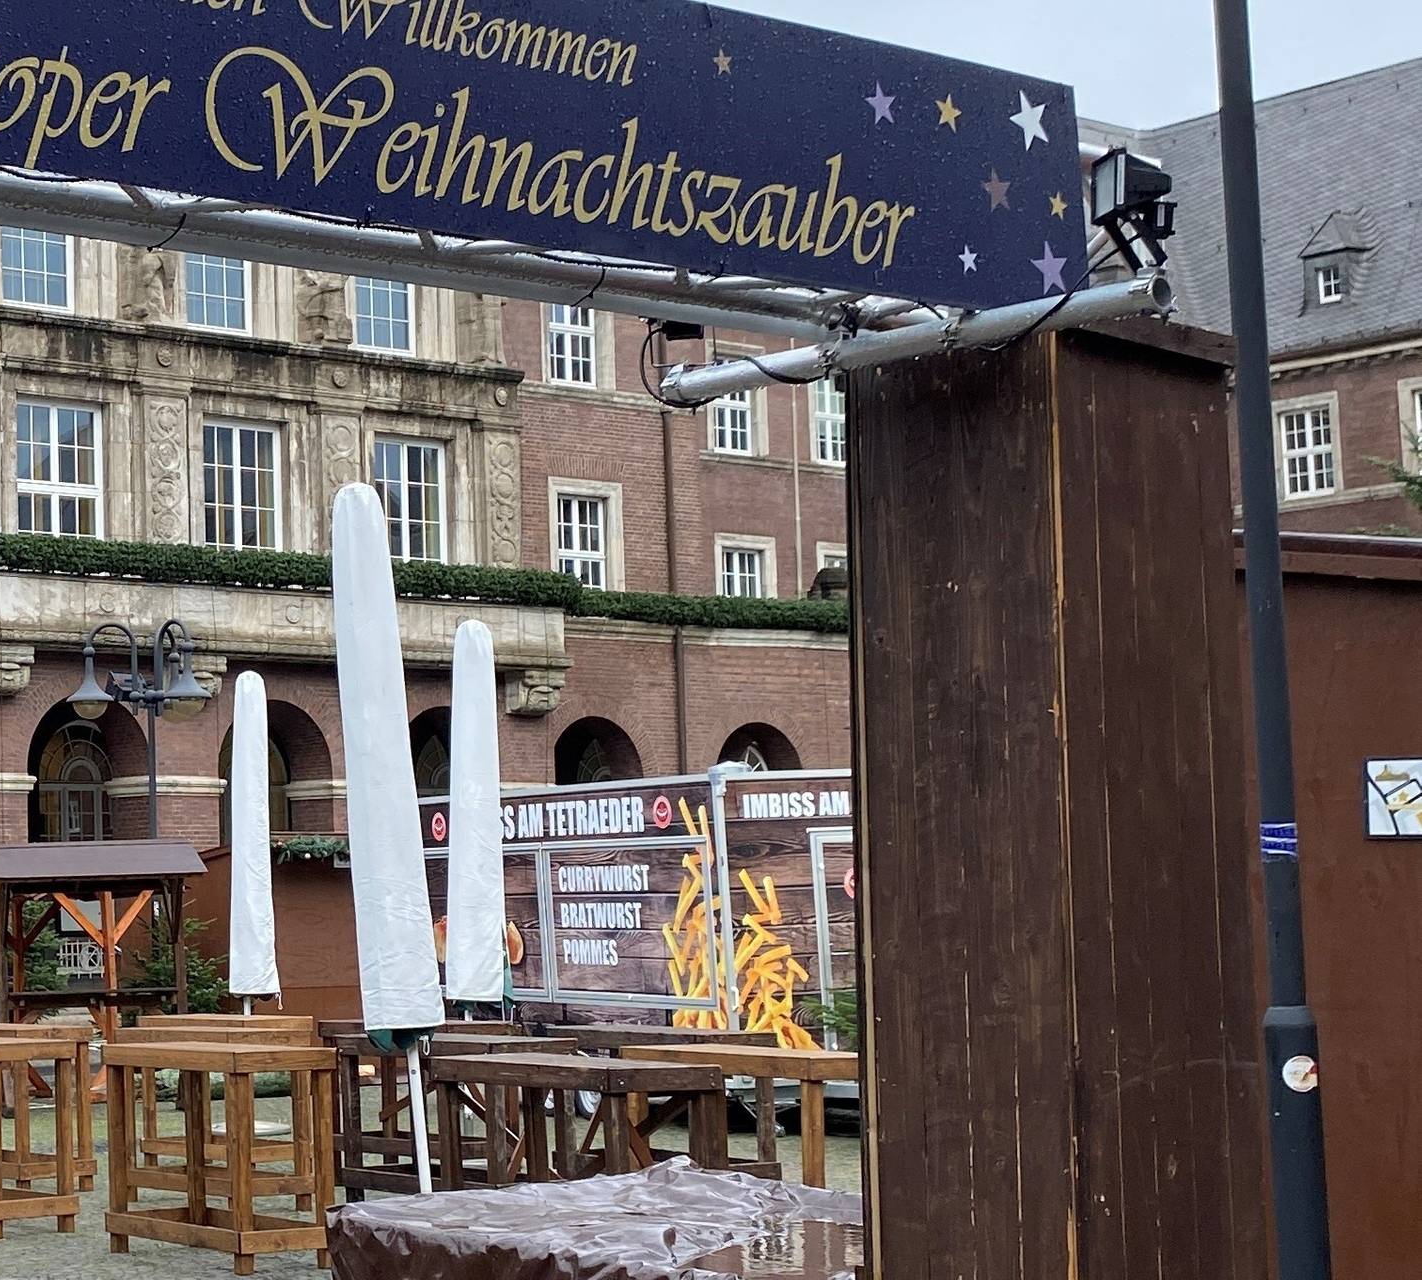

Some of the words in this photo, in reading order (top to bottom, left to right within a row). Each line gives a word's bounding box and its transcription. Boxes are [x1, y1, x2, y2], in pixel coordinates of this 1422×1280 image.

[297, 0, 638, 87] Willkommen
[205, 46, 915, 269] Weihnachtszauber
[518, 802, 544, 839] AM
[546, 796, 646, 837] TETRAEDER
[742, 792, 816, 819] IMBISS
[819, 790, 851, 817] AM
[558, 864, 650, 893] CURRYWURST
[560, 902, 642, 929] BRATWURST
[562, 939, 619, 966] POMMES
